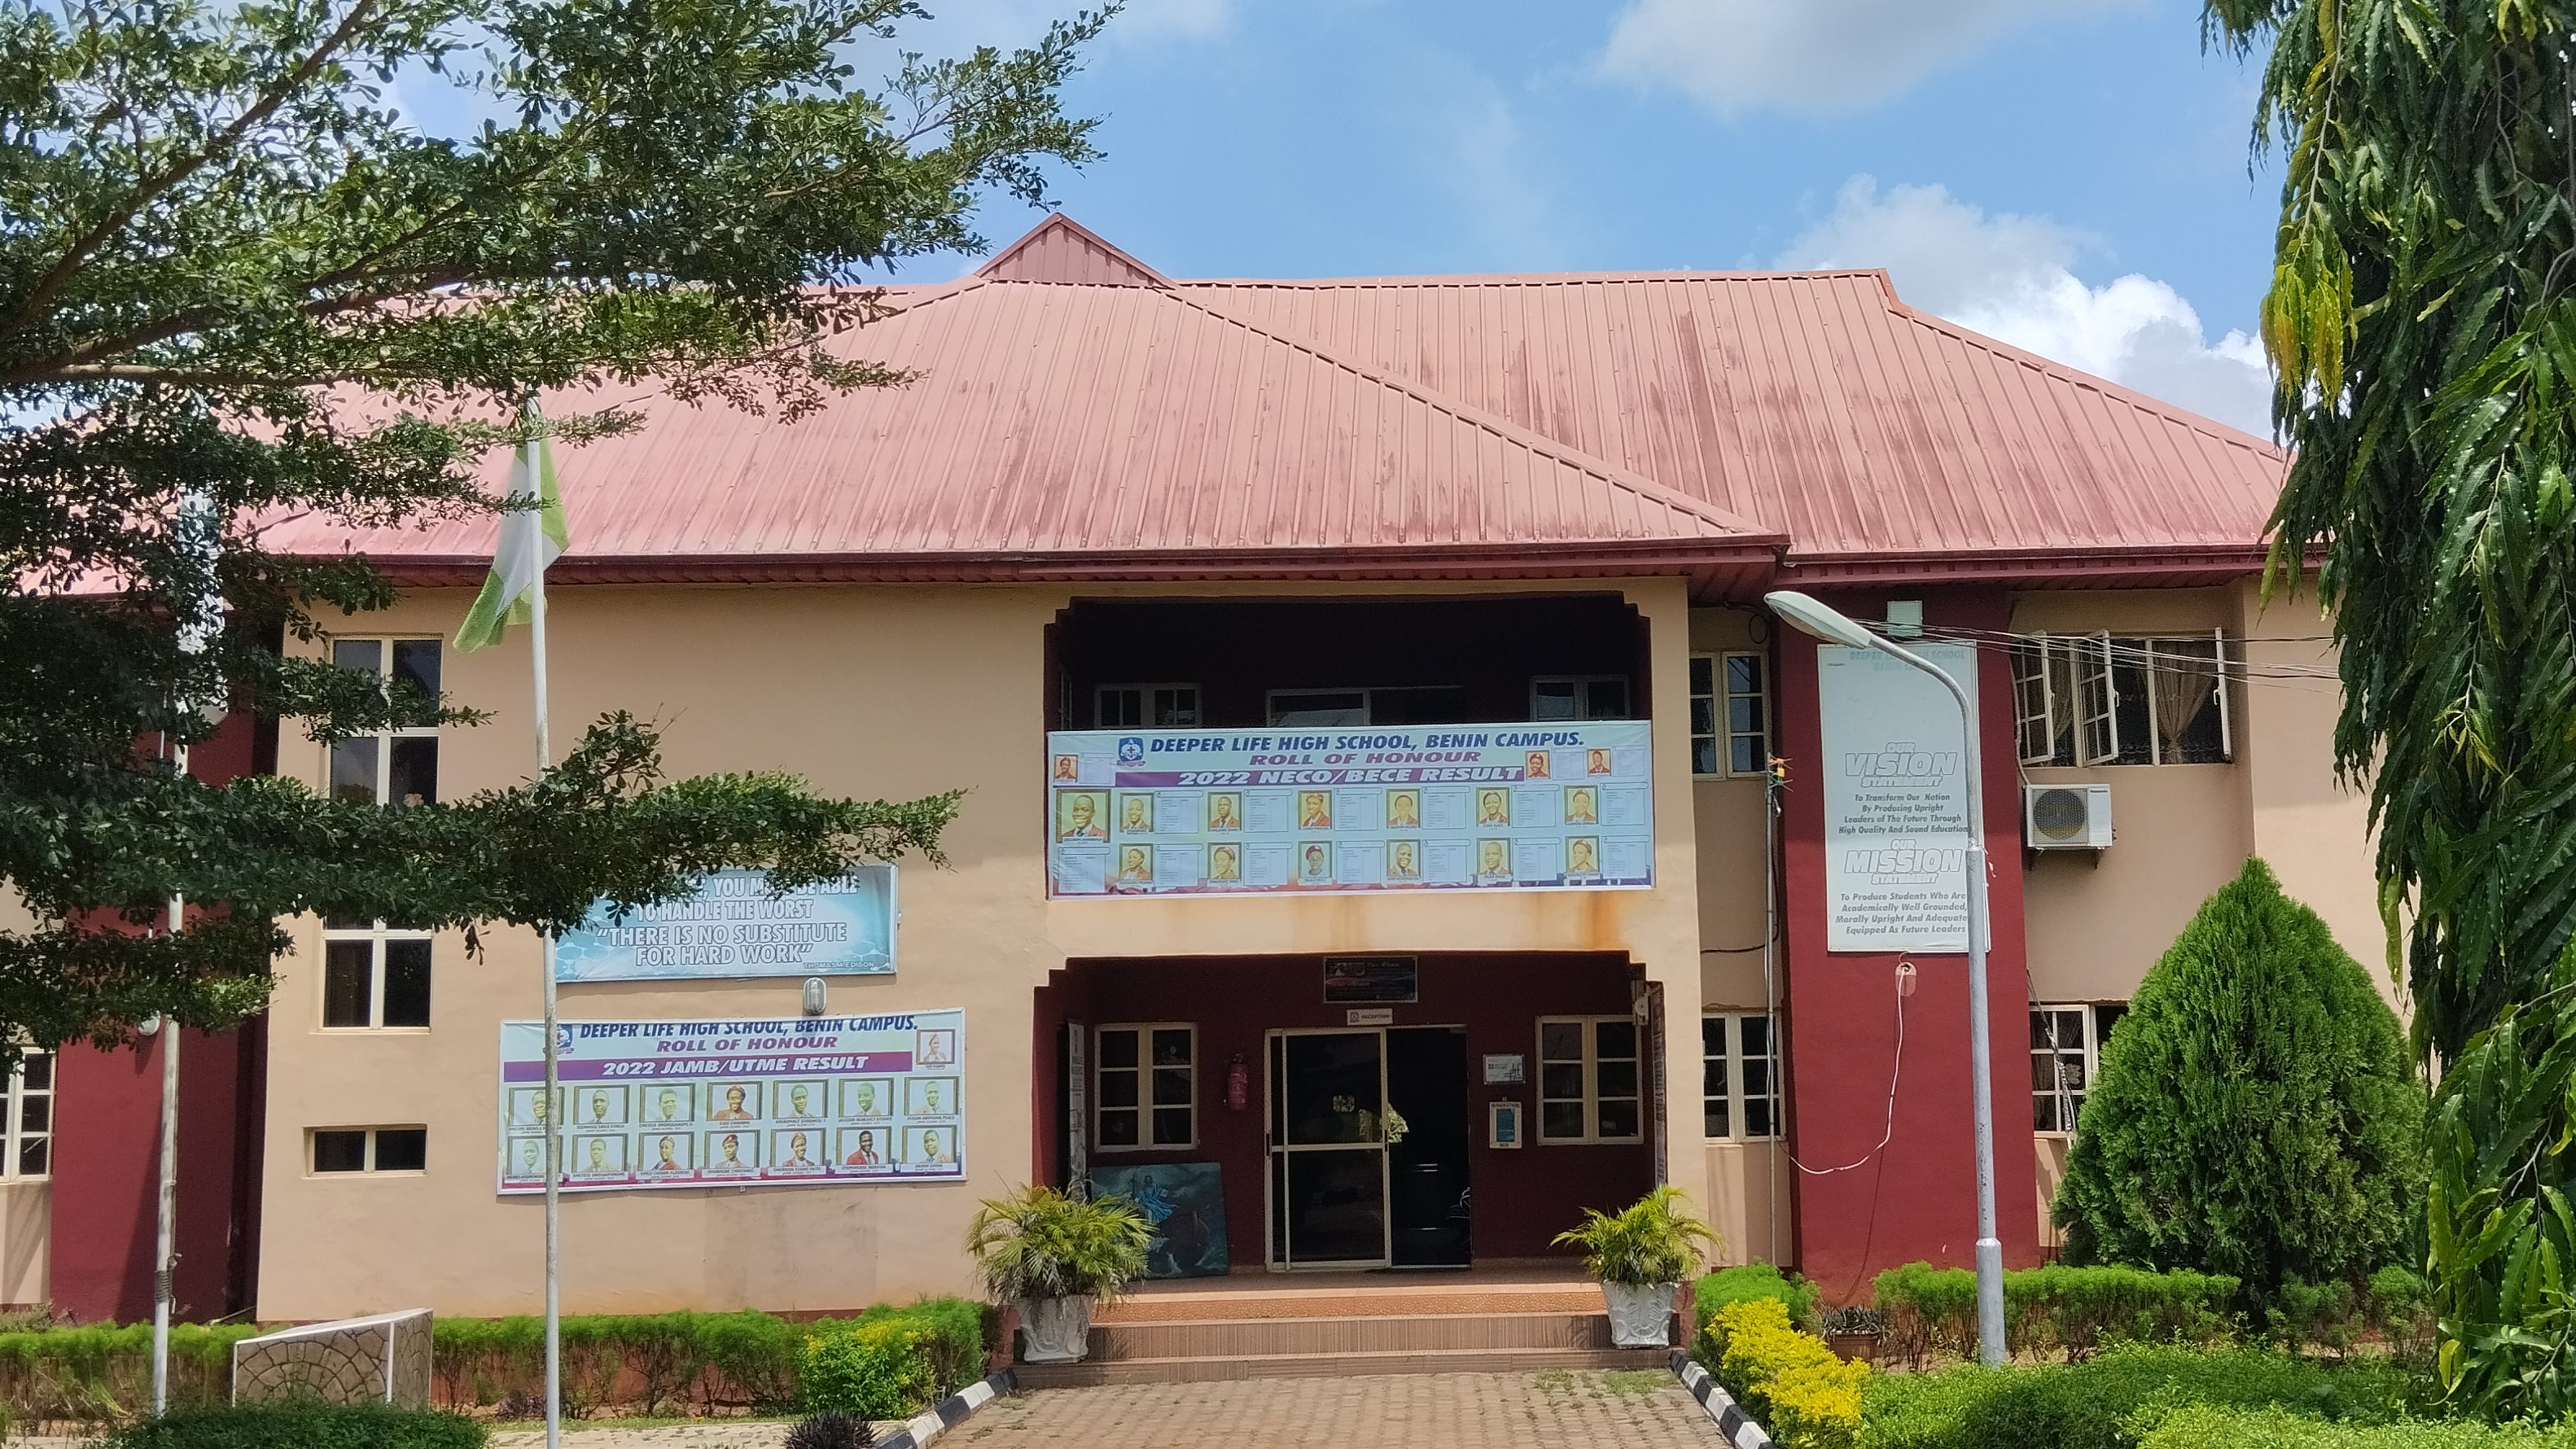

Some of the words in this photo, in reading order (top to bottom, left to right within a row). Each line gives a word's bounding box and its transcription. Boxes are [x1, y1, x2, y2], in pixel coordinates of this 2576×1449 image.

[1150, 738, 1224, 753] DEEPER
[1231, 737, 1271, 751] LIFE
[1277, 736, 1330, 751] HIGH
[1335, 734, 1417, 751] SCHOOL,
[1425, 733, 1488, 748] BENIN
[1495, 732, 1584, 747] CAMPUS.
[1886, 742, 1916, 754] OUR
[1250, 754, 1321, 766] ROLL
[1324, 753, 1356, 765] OF
[1365, 751, 1482, 764] HONOUR
[1845, 751, 1957, 777] VISION
[1176, 772, 1251, 786] 2022
[1258, 768, 1417, 786] NECO/BECE
[1419, 765, 1523, 783] RESULT
[1855, 794, 1863, 802] To
[1865, 793, 1904, 802] Transform
[1906, 793, 1920, 801] Our
[1925, 793, 1950, 801] Nation
[1862, 805, 1872, 813] By
[1873, 804, 1912, 813] Producing
[1914, 803, 1943, 812] Upright
[1844, 815, 1875, 823] Leaders
[1877, 815, 1885, 823] of
[1903, 814, 1927, 822] Future
[1930, 814, 1961, 823] Through
[1838, 826, 1855, 835] High
[1858, 825, 1886, 834] Quality
[1888, 825, 1903, 833] And
[1904, 825, 1929, 833] Sound
[1890, 839, 1917, 851] OUR
[1844, 849, 1963, 873] MISSION
[712, 877, 746, 897] YOU
[819, 875, 859, 895] ABLE
[1841, 893, 1850, 901] To
[1852, 892, 1888, 901] Produce
[1890, 891, 1928, 900] Students
[1930, 891, 1948, 900] Who
[1951, 891, 1966, 900] Are
[636, 901, 657, 921] TO
[660, 900, 721, 921] HANDLE
[725, 900, 755, 921] THE
[757, 898, 814, 920] WORST
[1842, 903, 1899, 913] Academically
[1901, 902, 1921, 911] Well
[1923, 902, 1967, 912] Grounded,
[1835, 914, 1869, 925] Morally
[1871, 914, 1904, 924] Upright
[1907, 913, 1923, 921] And
[596, 926, 669, 948] "THERE
[674, 926, 693, 945] IS
[698, 924, 729, 944] NO
[733, 922, 848, 944] SUBSTITUTE
[1846, 926, 1886, 935] Equipped
[1889, 926, 1899, 934] As
[1901, 925, 1930, 934] Future
[1931, 923, 1966, 933] Leaders
[636, 946, 676, 966] FOR
[680, 944, 736, 965] HARD
[739, 943, 814, 964] WORK"
[846, 961, 876, 969] EDISON
[579, 1022, 639, 1039] DEEPER
[643, 1022, 675, 1037] LIFE
[679, 1022, 720, 1036] HIGH
[724, 1022, 789, 1036] SCHOOL,
[795, 1018, 843, 1033] BENIN
[848, 1015, 918, 1031] CAMPUS.
[656, 1039, 707, 1053] ROLL
[714, 1038, 743, 1051] OF
[747, 1036, 839, 1051] HONOUR
[601, 1062, 656, 1076] 2022
[659, 1057, 788, 1075] JAMB/UTME
[792, 1055, 870, 1071] RESULT
